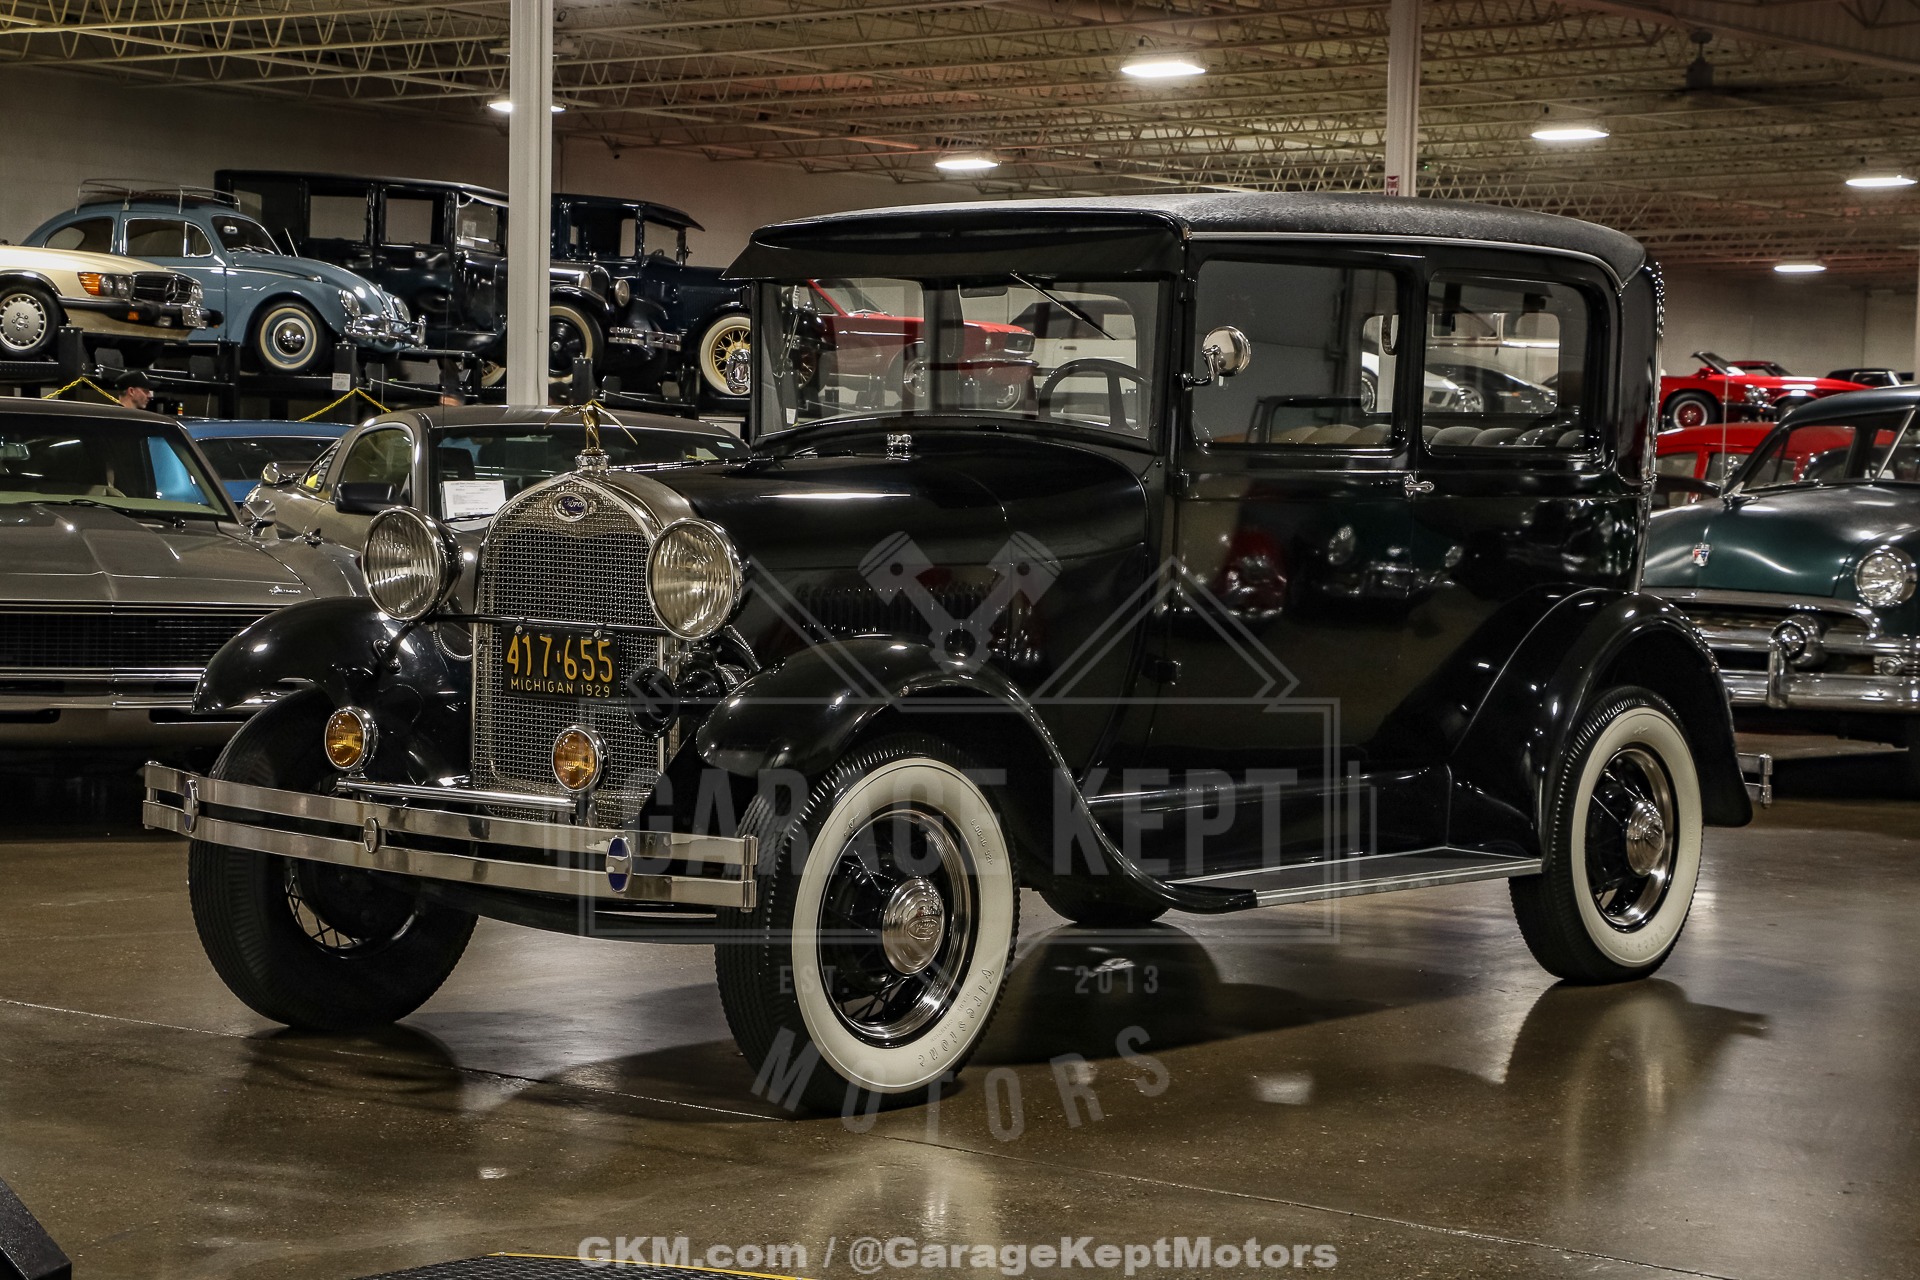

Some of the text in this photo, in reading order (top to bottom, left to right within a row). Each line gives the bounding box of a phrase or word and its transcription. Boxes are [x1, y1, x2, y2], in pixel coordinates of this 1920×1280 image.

[510, 678, 611, 698] MICHIGAN 1929
[918, 968, 995, 1068] Firestone
